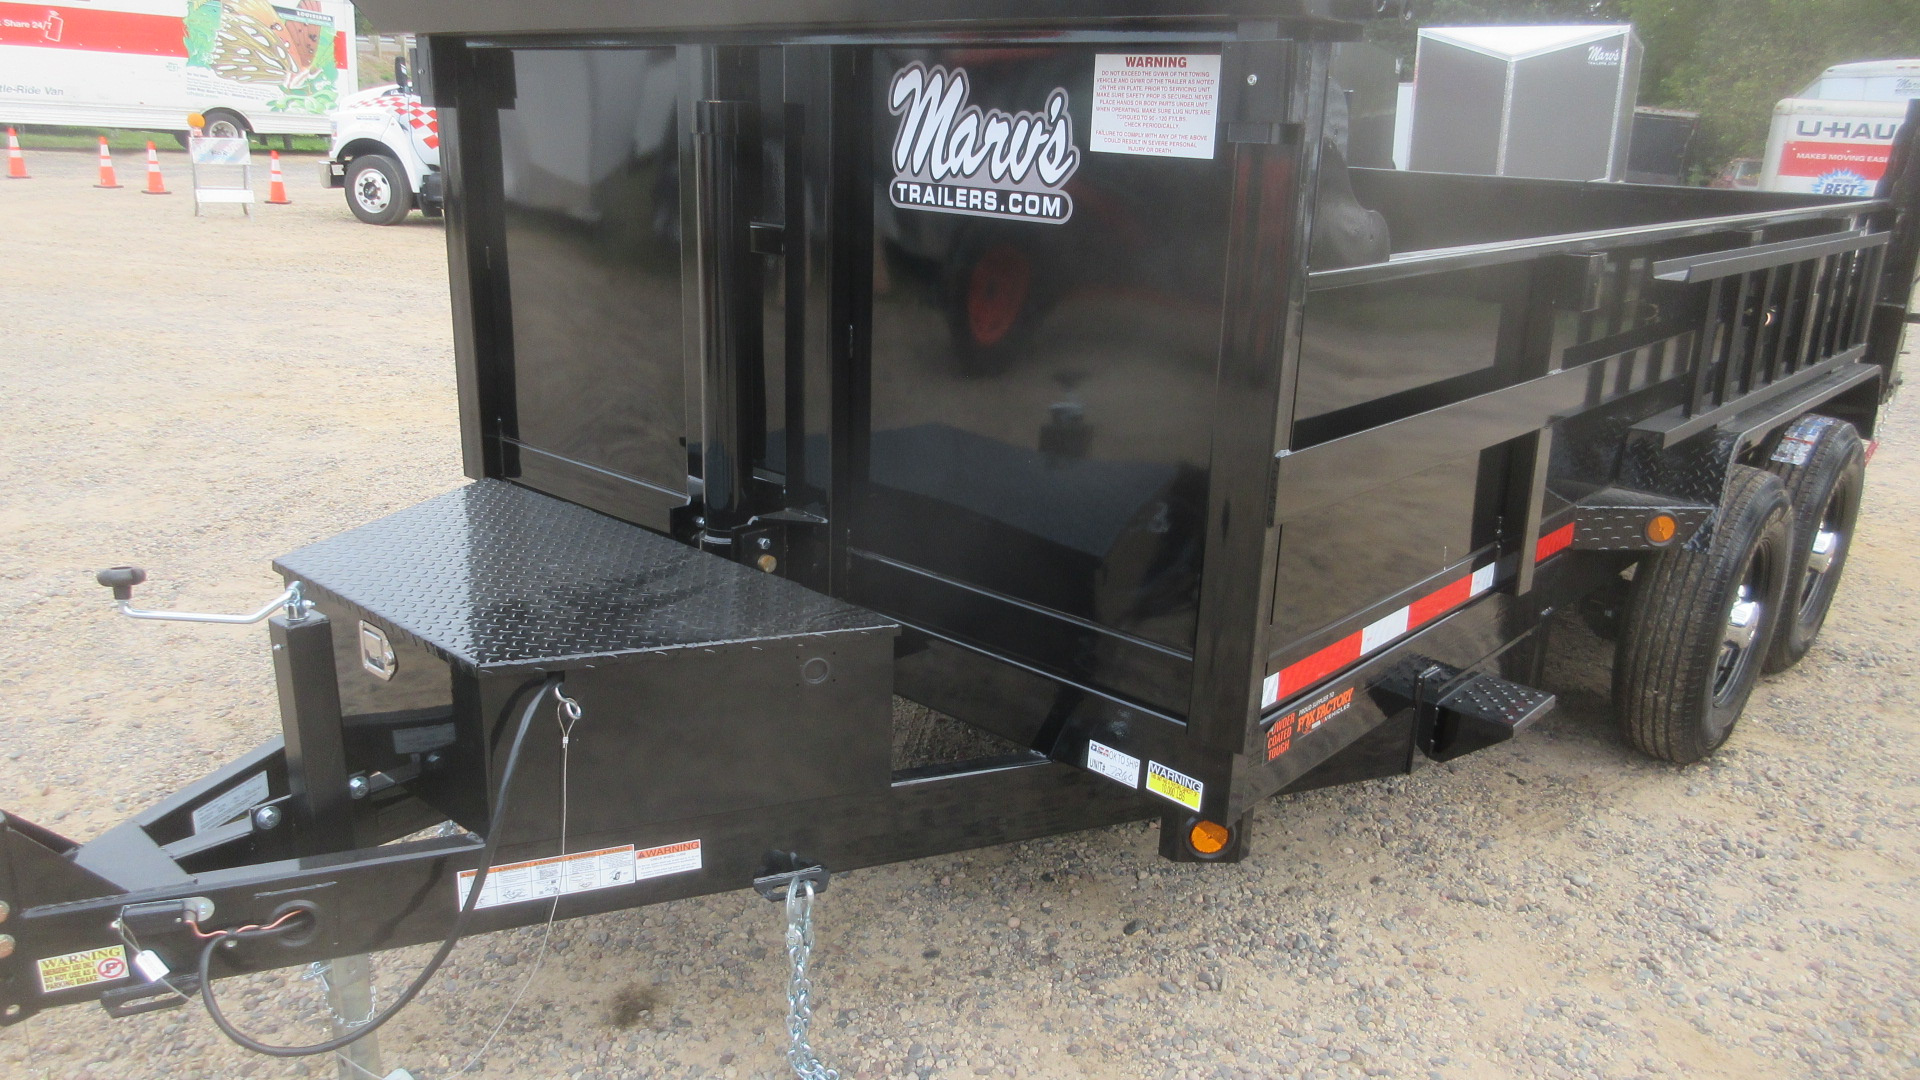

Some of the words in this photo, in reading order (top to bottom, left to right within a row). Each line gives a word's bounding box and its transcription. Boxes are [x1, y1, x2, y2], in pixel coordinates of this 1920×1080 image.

[1125, 56, 1187, 68] WARNING
[44, 87, 64, 96] Van
[892, 66, 1075, 184] Marv's
[1828, 154, 1865, 162] MOVING
[1822, 183, 1859, 195] BEST
[896, 182, 1062, 218] TRAILERS.COM
[1296, 711, 1316, 733] FOX
[1316, 687, 1355, 719] FACTORY
[1325, 703, 1351, 721] VEHICLES
[1267, 726, 1292, 749] COATED
[1268, 739, 1290, 761] TOUGH
[1110, 751, 1117, 762] OK
[1118, 754, 1125, 765] TO
[1126, 757, 1139, 770] SHIP
[1150, 763, 1201, 793] WARNING
[646, 842, 700, 857] WARNING
[42, 948, 121, 968] WARNING
[76, 975, 98, 984] BRAKE
